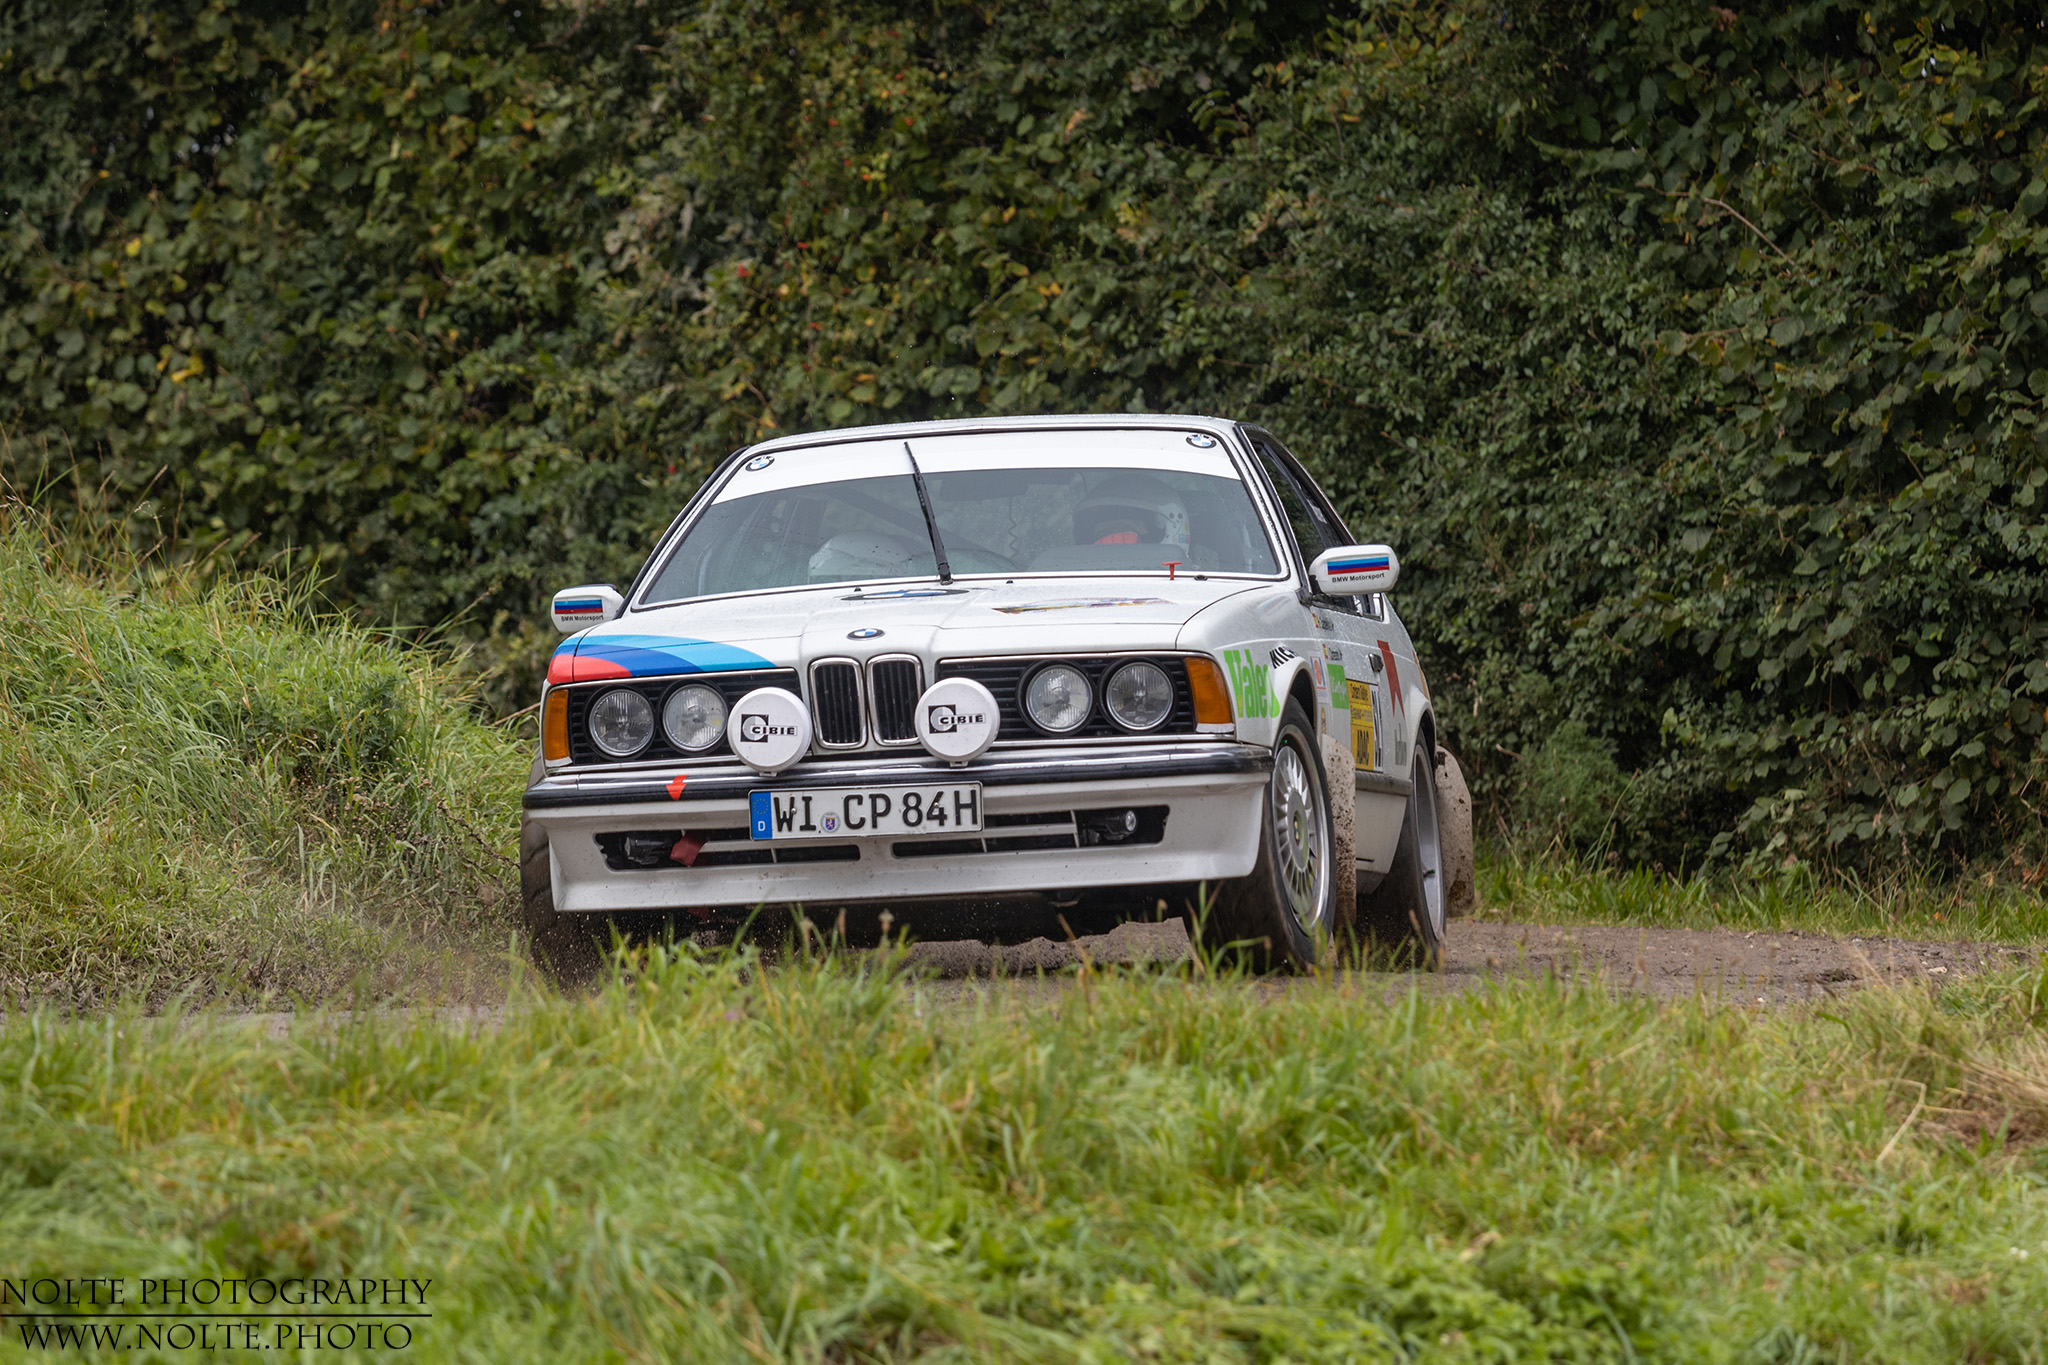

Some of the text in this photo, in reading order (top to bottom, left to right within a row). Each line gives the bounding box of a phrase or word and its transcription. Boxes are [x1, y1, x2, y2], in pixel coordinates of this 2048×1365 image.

[1350, 573, 1385, 582] Motorsport
[1223, 648, 1281, 719] Valeo
[758, 789, 978, 833] D WI CP 84H
